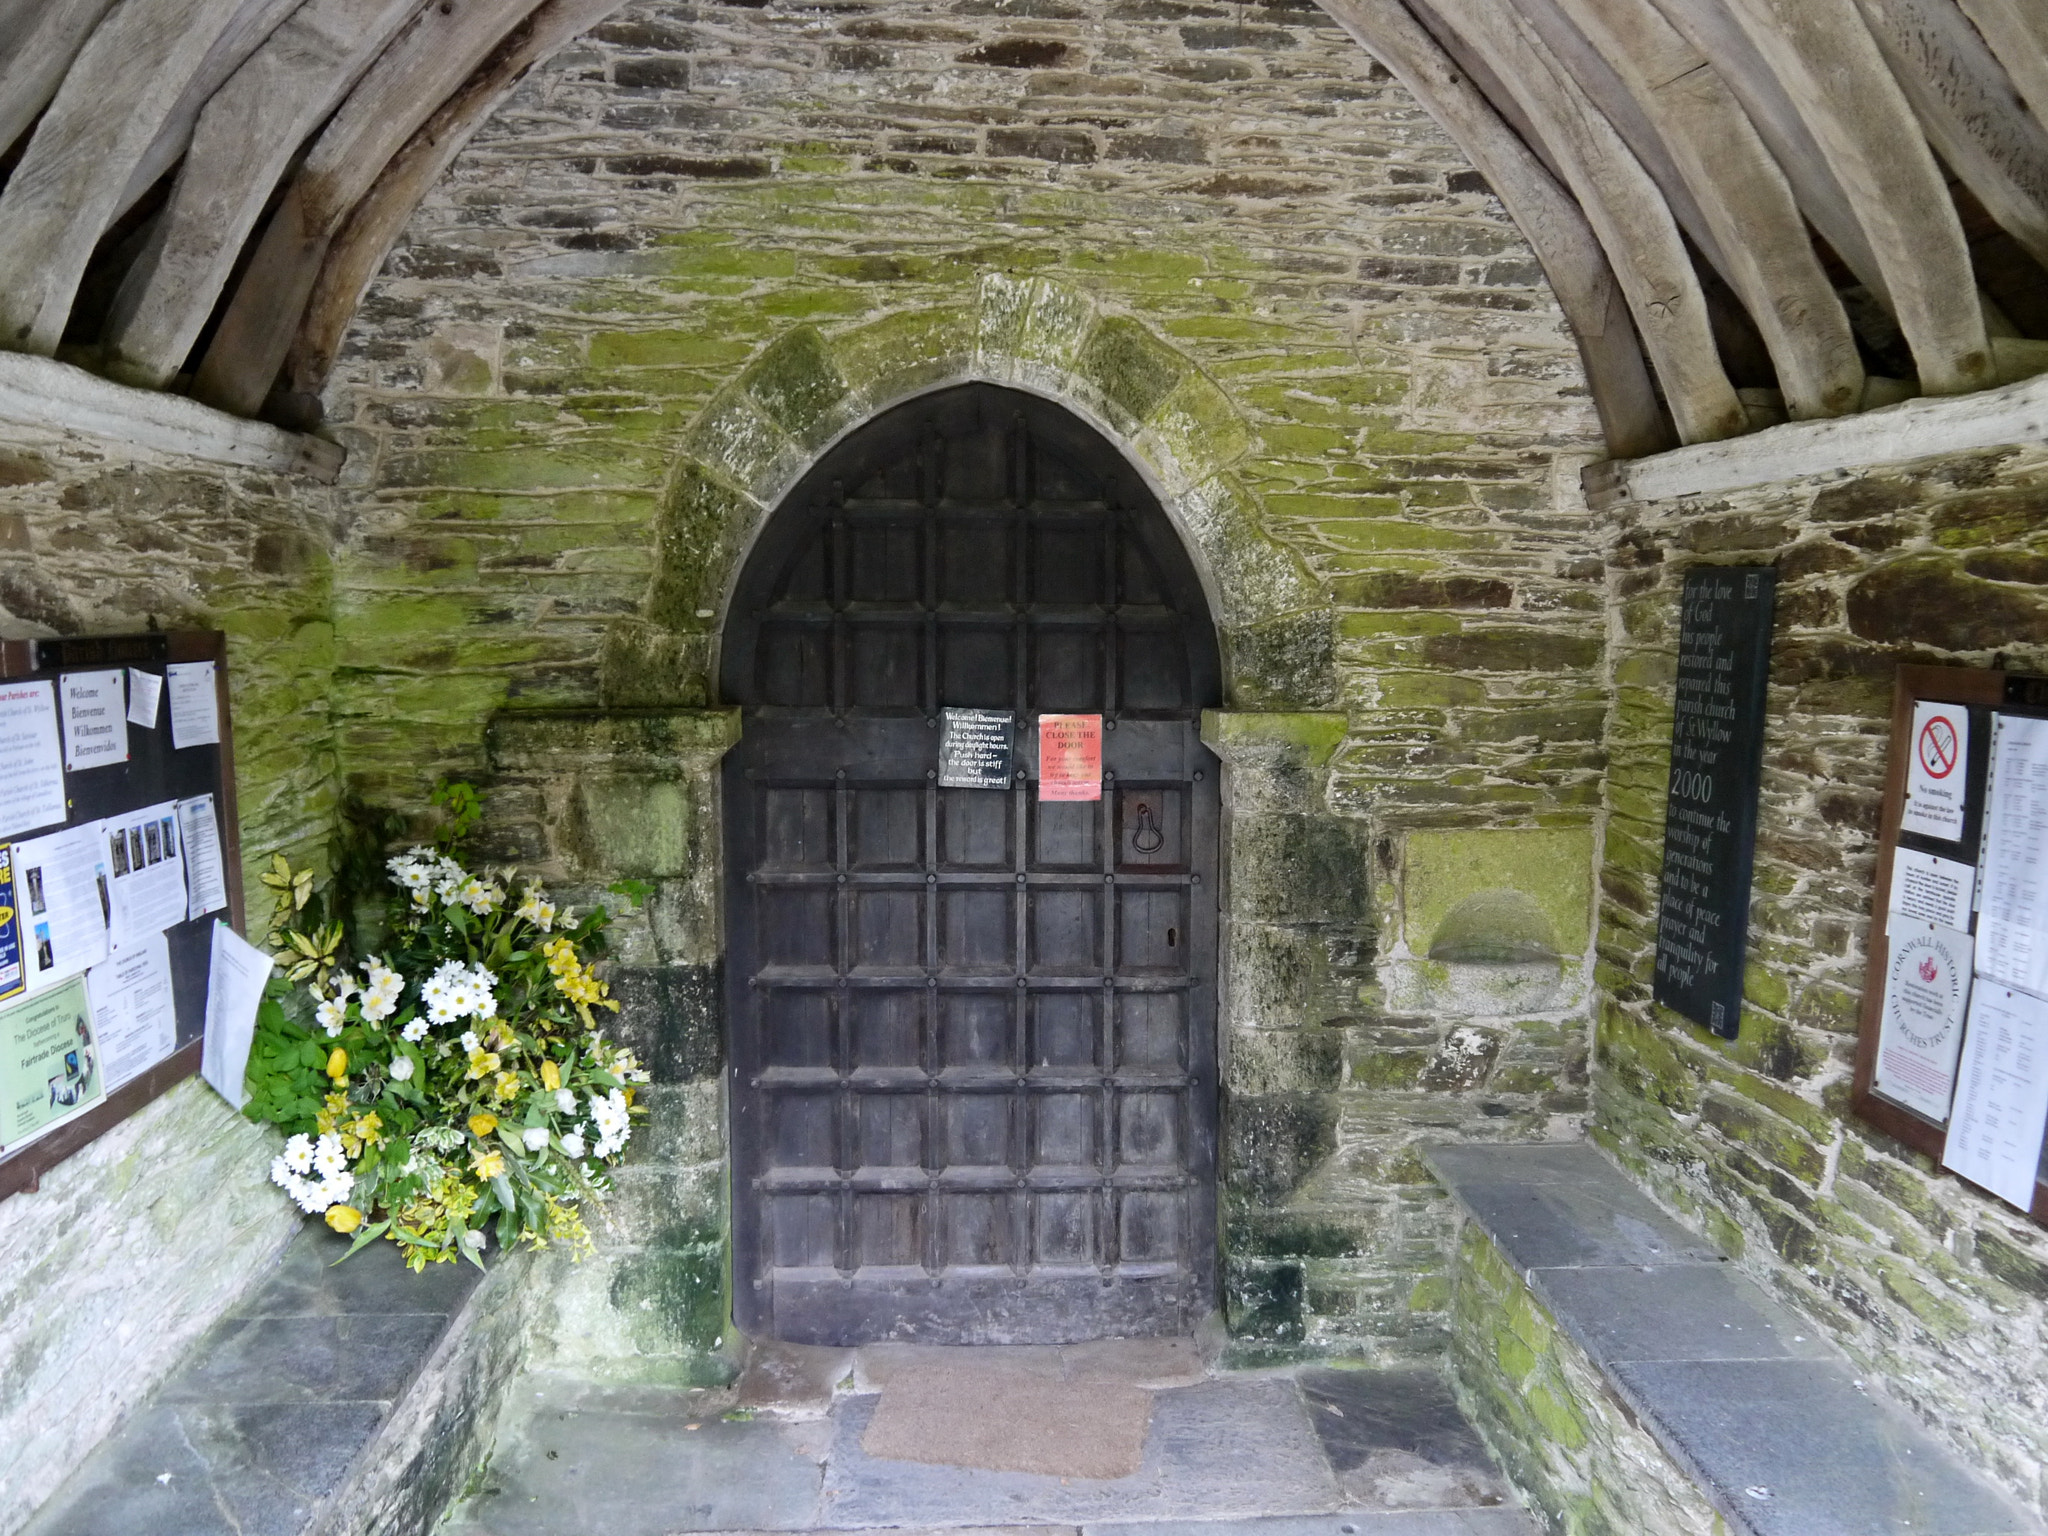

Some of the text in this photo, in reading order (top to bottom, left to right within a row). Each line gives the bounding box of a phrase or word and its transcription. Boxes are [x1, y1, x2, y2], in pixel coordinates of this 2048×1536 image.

[1685, 578, 1732, 602] for the love
[1684, 601, 1713, 624] of God
[1682, 624, 1722, 652] his people
[1680, 649, 1734, 671] restored and
[70, 687, 99, 699] Welcome
[1678, 672, 1731, 697] repaired this
[71, 706, 106, 719] Bienvenue
[946, 712, 1012, 723] Welcome! Bienvenue!
[1676, 693, 1736, 720] parish church
[950, 731, 961, 740] The
[962, 732, 983, 741] Church
[1045, 731, 1096, 739] CLOSE THE
[1675, 715, 1685, 737] of
[1698, 718, 1732, 748] Wyllow
[945, 740, 964, 750] during
[965, 741, 989, 751] daylight
[954, 750, 973, 759] Push
[1683, 739, 1696, 759] the
[1699, 750, 1718, 770] year
[967, 767, 982, 775] but
[985, 760, 1002, 769] stiff
[983, 776, 1007, 786] great!
[1671, 768, 1712, 803] 2000
[1920, 784, 1952, 800] No smoking
[1668, 802, 1731, 833] to continue the
[1667, 824, 1714, 855] worship of
[1666, 850, 1713, 875] generations
[1664, 867, 1709, 898] and to be a
[1661, 887, 1720, 927] place of peace
[1660, 915, 1706, 944] prayer and
[1657, 953, 1694, 989] all people
[1705, 951, 1719, 975] for
[1892, 936, 1959, 1000] CORNWALL HISTORIC
[14, 1013, 71, 1044] The Diocese of Truro
[1891, 994, 1954, 1048] CHURCHES TRUST
[21, 1039, 73, 1069] Fairtrade Diocese
